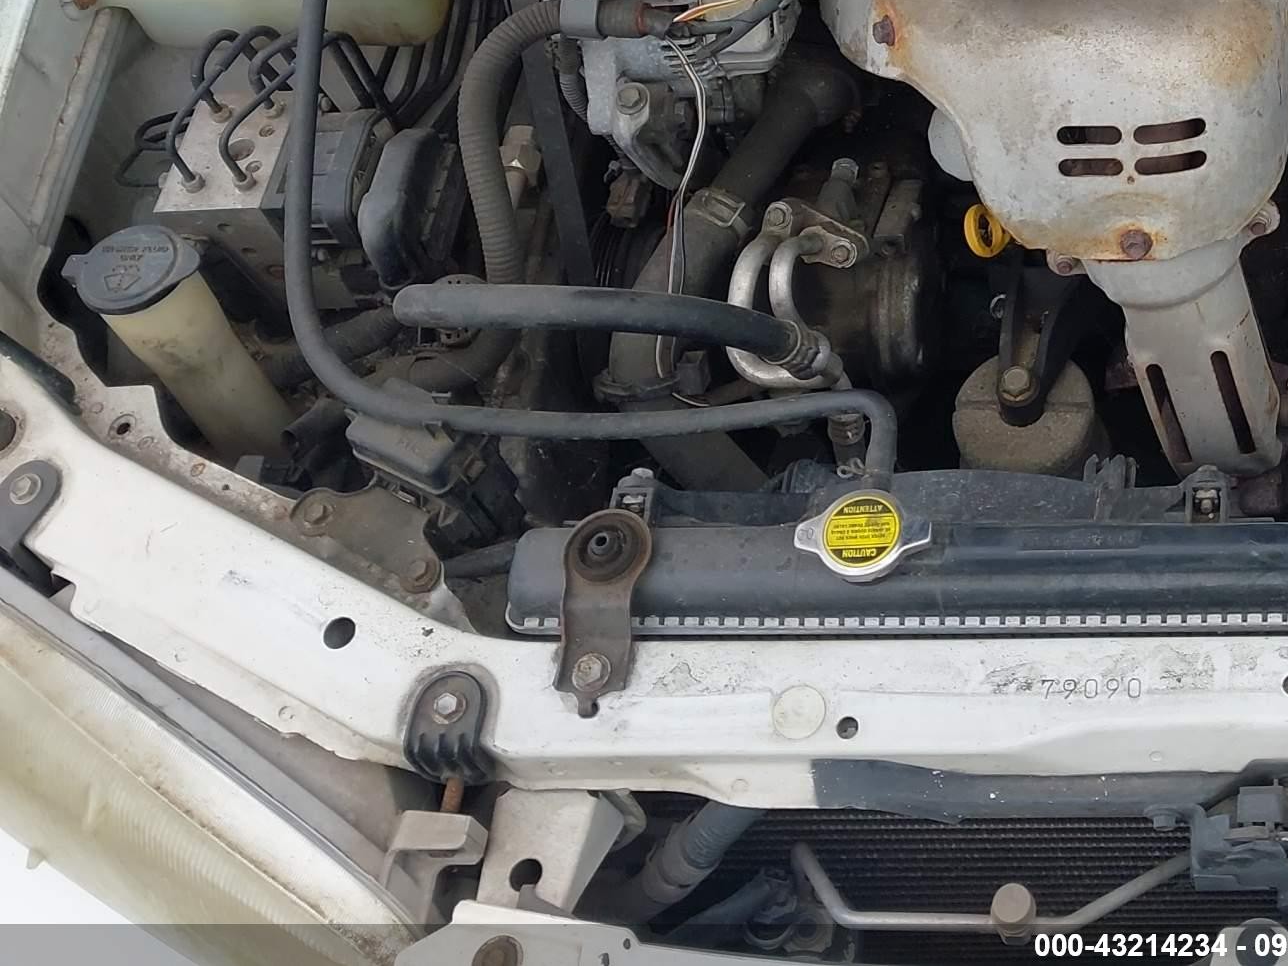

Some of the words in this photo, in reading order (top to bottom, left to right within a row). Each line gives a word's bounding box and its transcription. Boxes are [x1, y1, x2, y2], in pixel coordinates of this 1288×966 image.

[843, 505, 883, 514] ATTENTION
[842, 549, 877, 558] CAUTION
[1041, 678, 1142, 699] 79090
